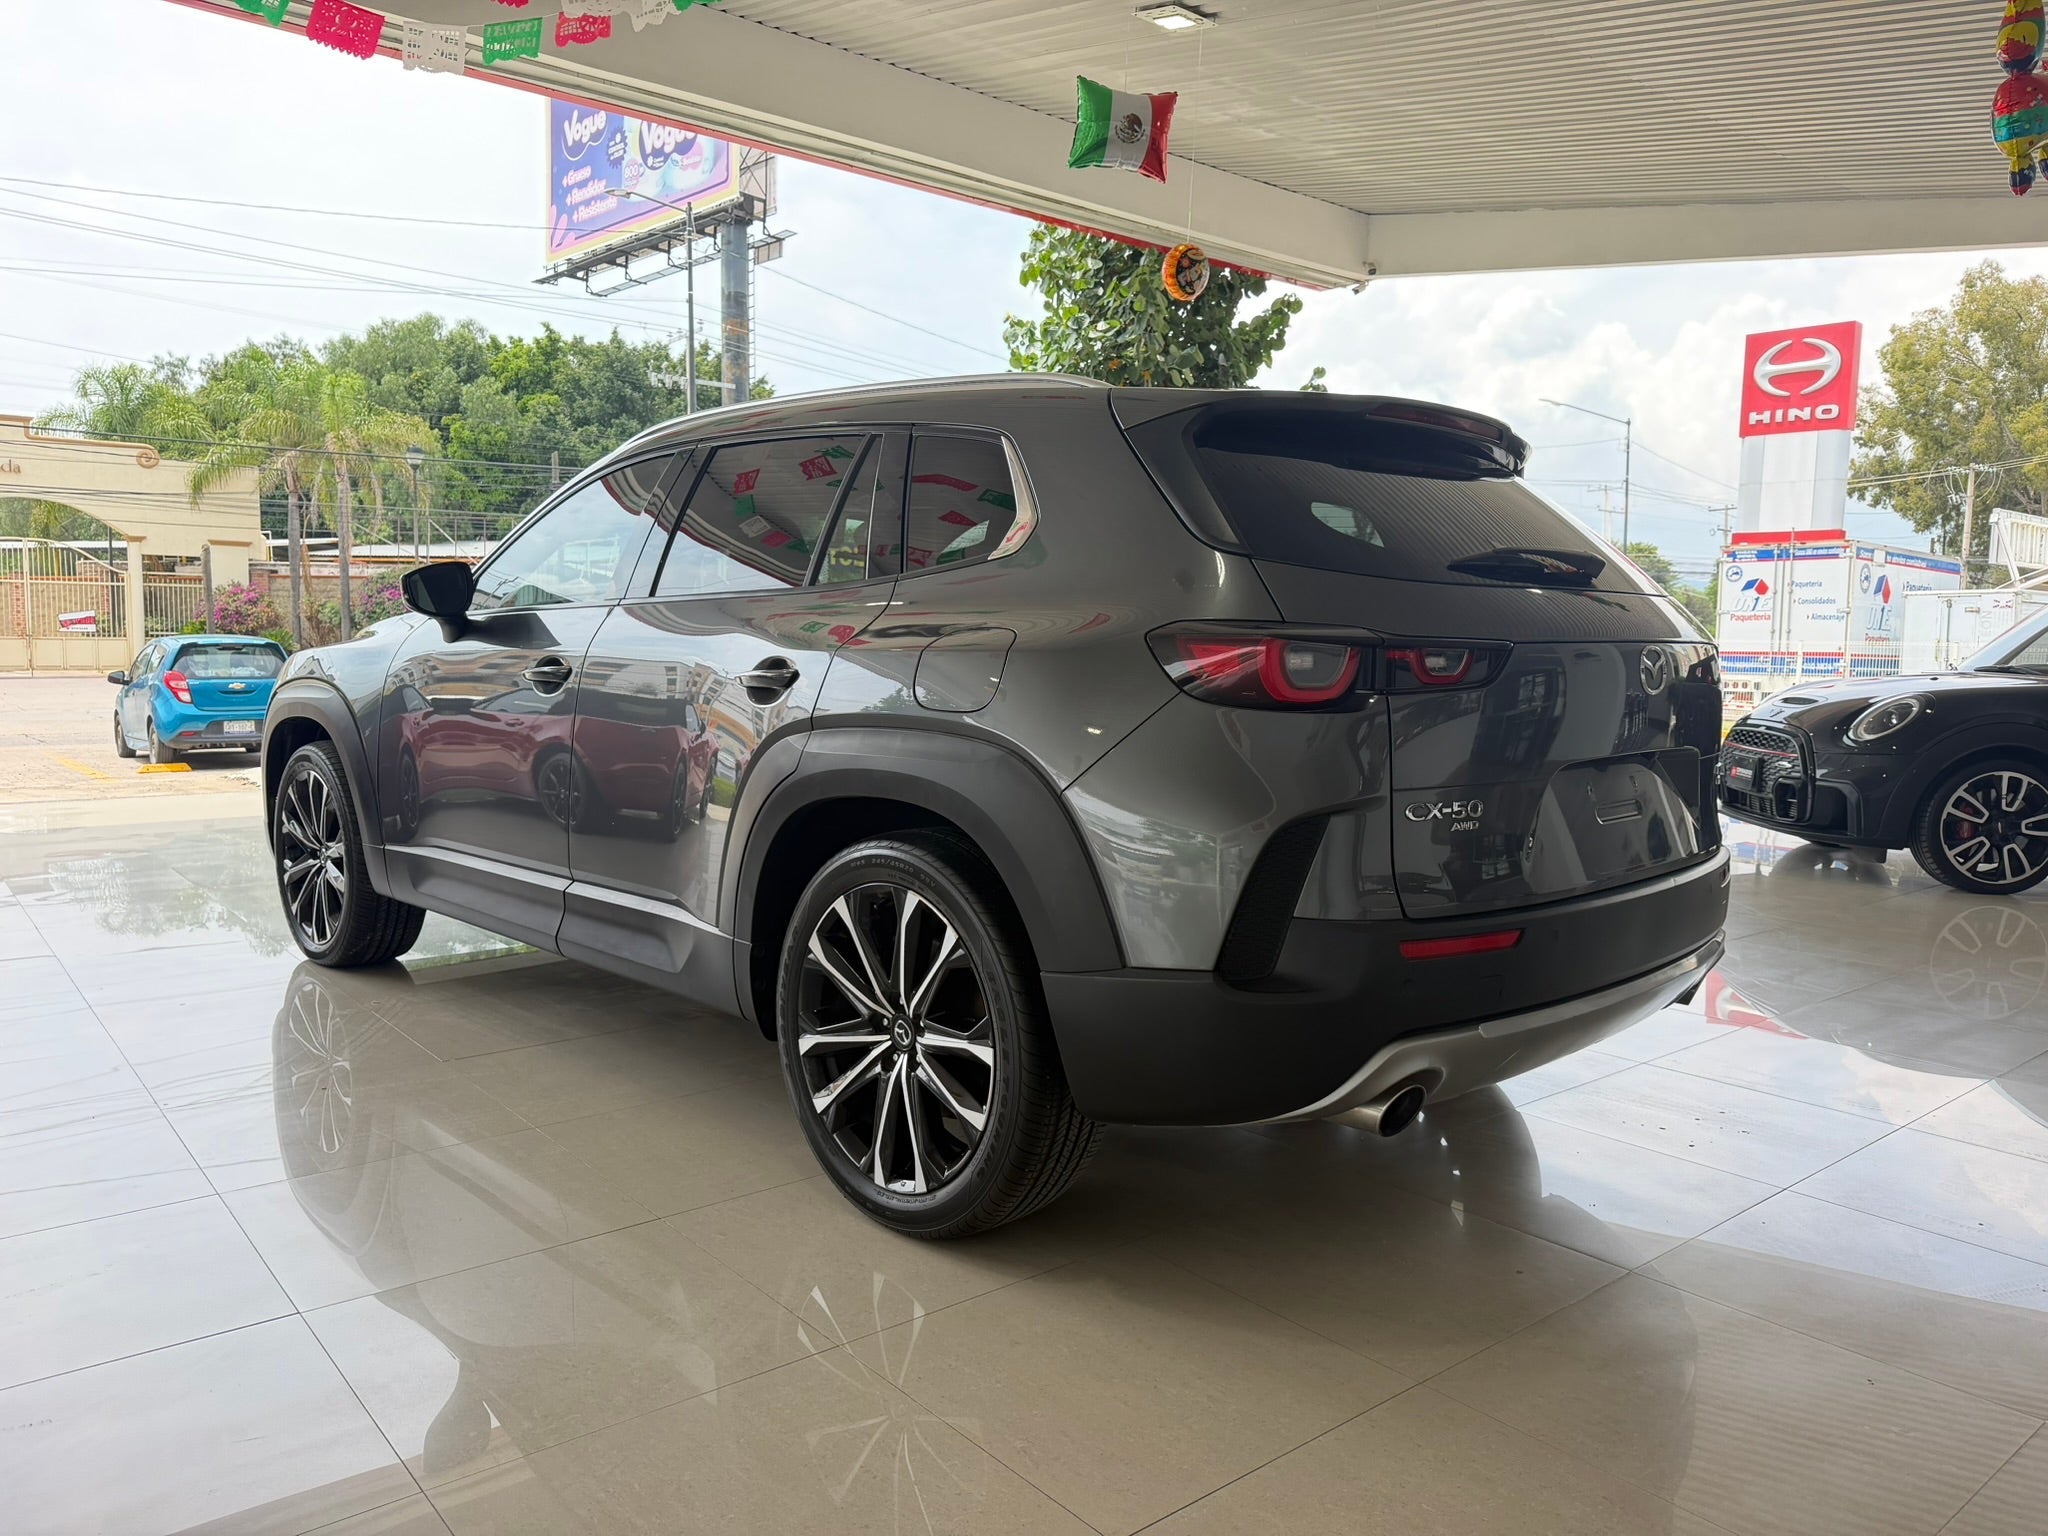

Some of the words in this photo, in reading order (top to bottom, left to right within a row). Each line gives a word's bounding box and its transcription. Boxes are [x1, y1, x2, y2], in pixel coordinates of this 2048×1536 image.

[564, 109, 607, 147] Vogue
[1748, 404, 1840, 425] HINO
[1730, 613, 1772, 623] Paqueteria
[1405, 799, 1484, 822] CX-50
[1450, 820, 1480, 832] AWD
